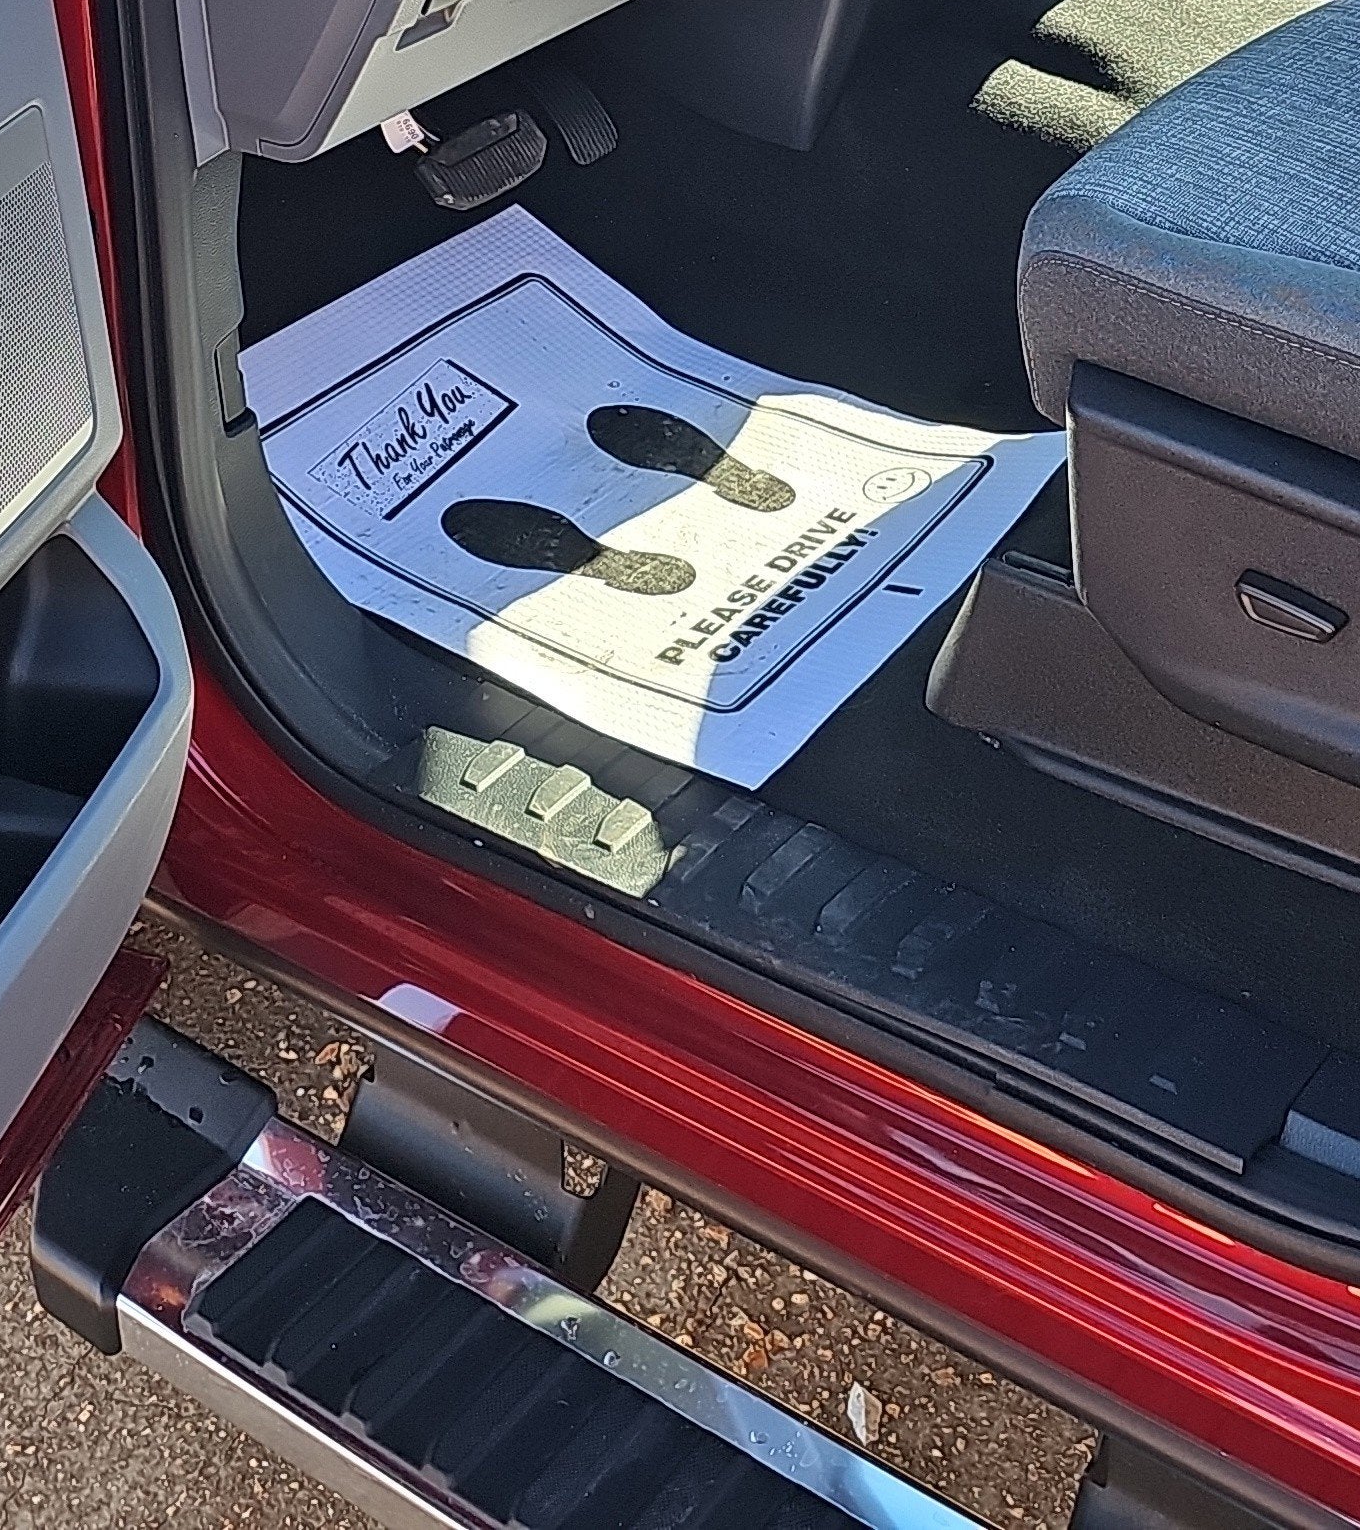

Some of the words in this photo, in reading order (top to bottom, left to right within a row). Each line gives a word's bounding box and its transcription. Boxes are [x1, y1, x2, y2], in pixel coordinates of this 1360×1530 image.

[337, 406, 427, 491] Thank
[416, 382, 472, 425] You
[392, 472, 413, 491] For
[409, 454, 434, 475] Your
[654, 574, 776, 666] PLEASE
[764, 507, 858, 574] DRIVE
[708, 527, 880, 663] CAREFULLY!
